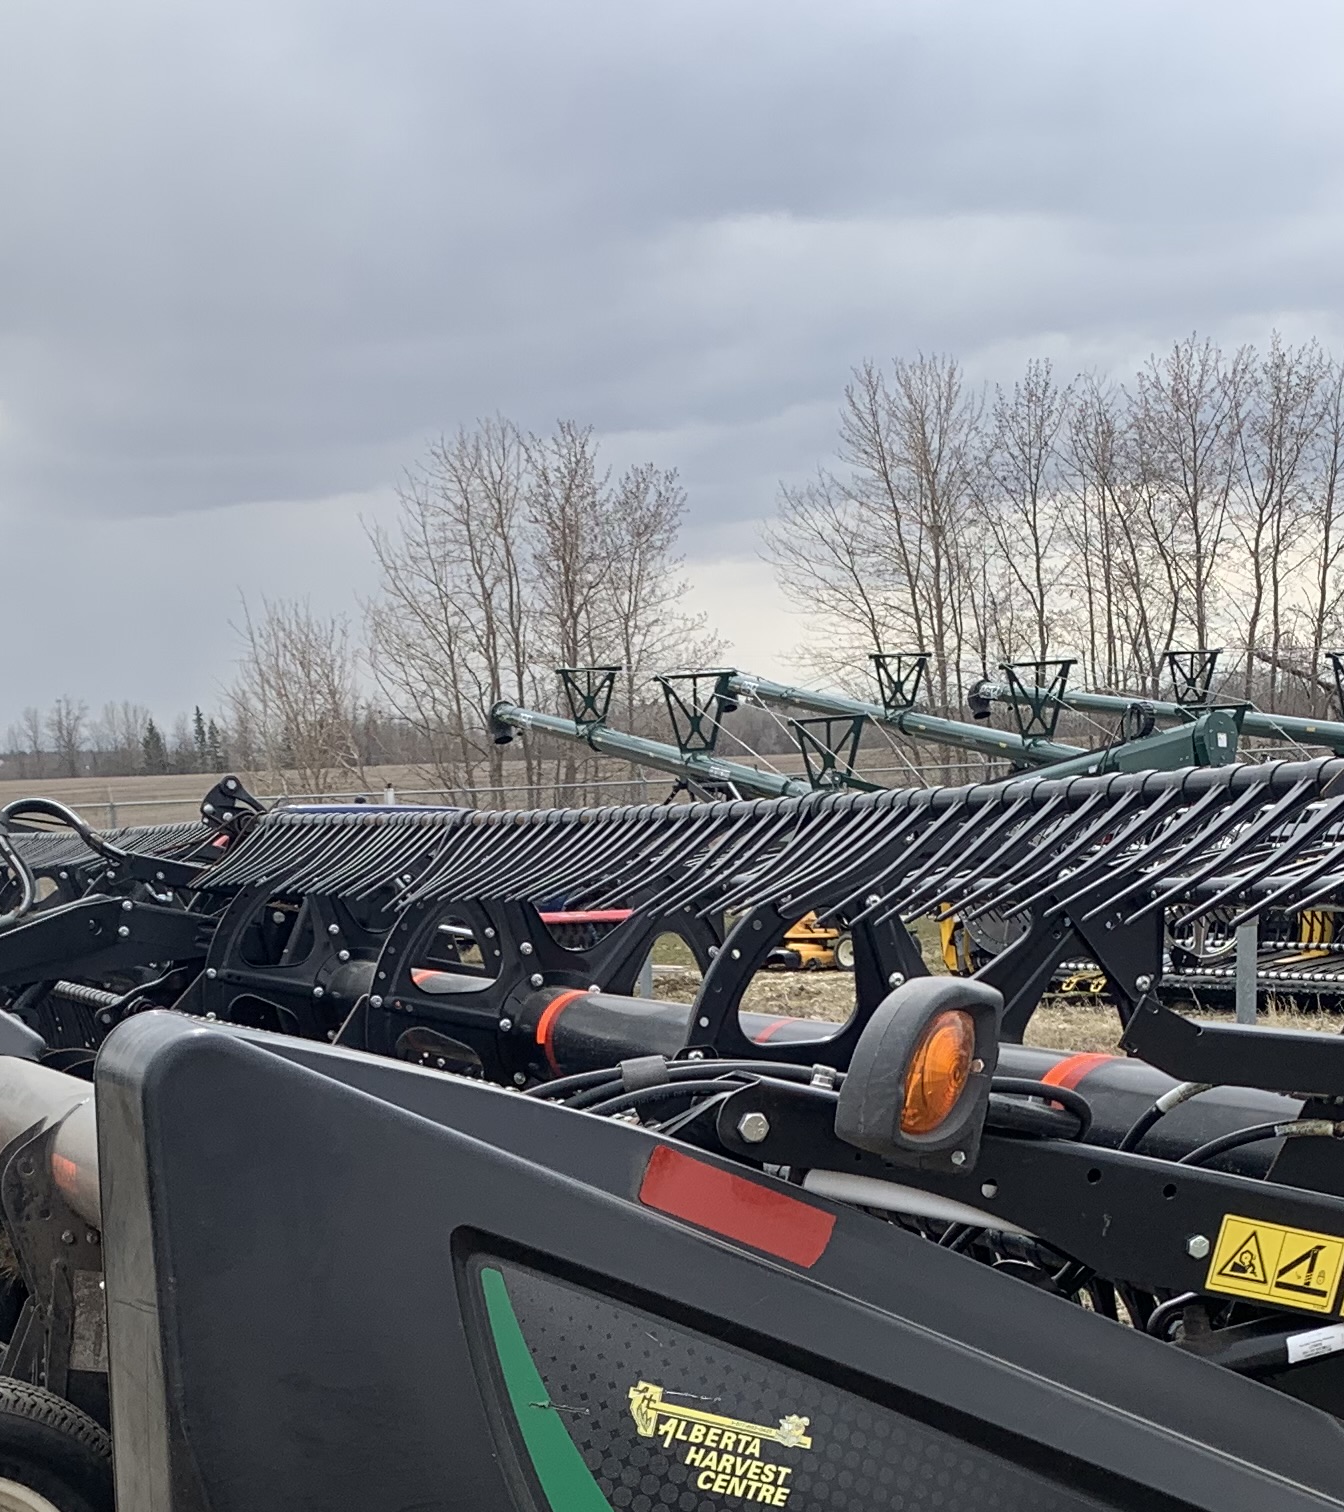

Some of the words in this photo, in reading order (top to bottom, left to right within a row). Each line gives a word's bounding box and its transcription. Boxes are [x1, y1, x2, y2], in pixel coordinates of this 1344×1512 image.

[658, 1418, 762, 1458] ALBERTA
[684, 1446, 792, 1486] HARVEST
[696, 1470, 791, 1507] CENTRE
